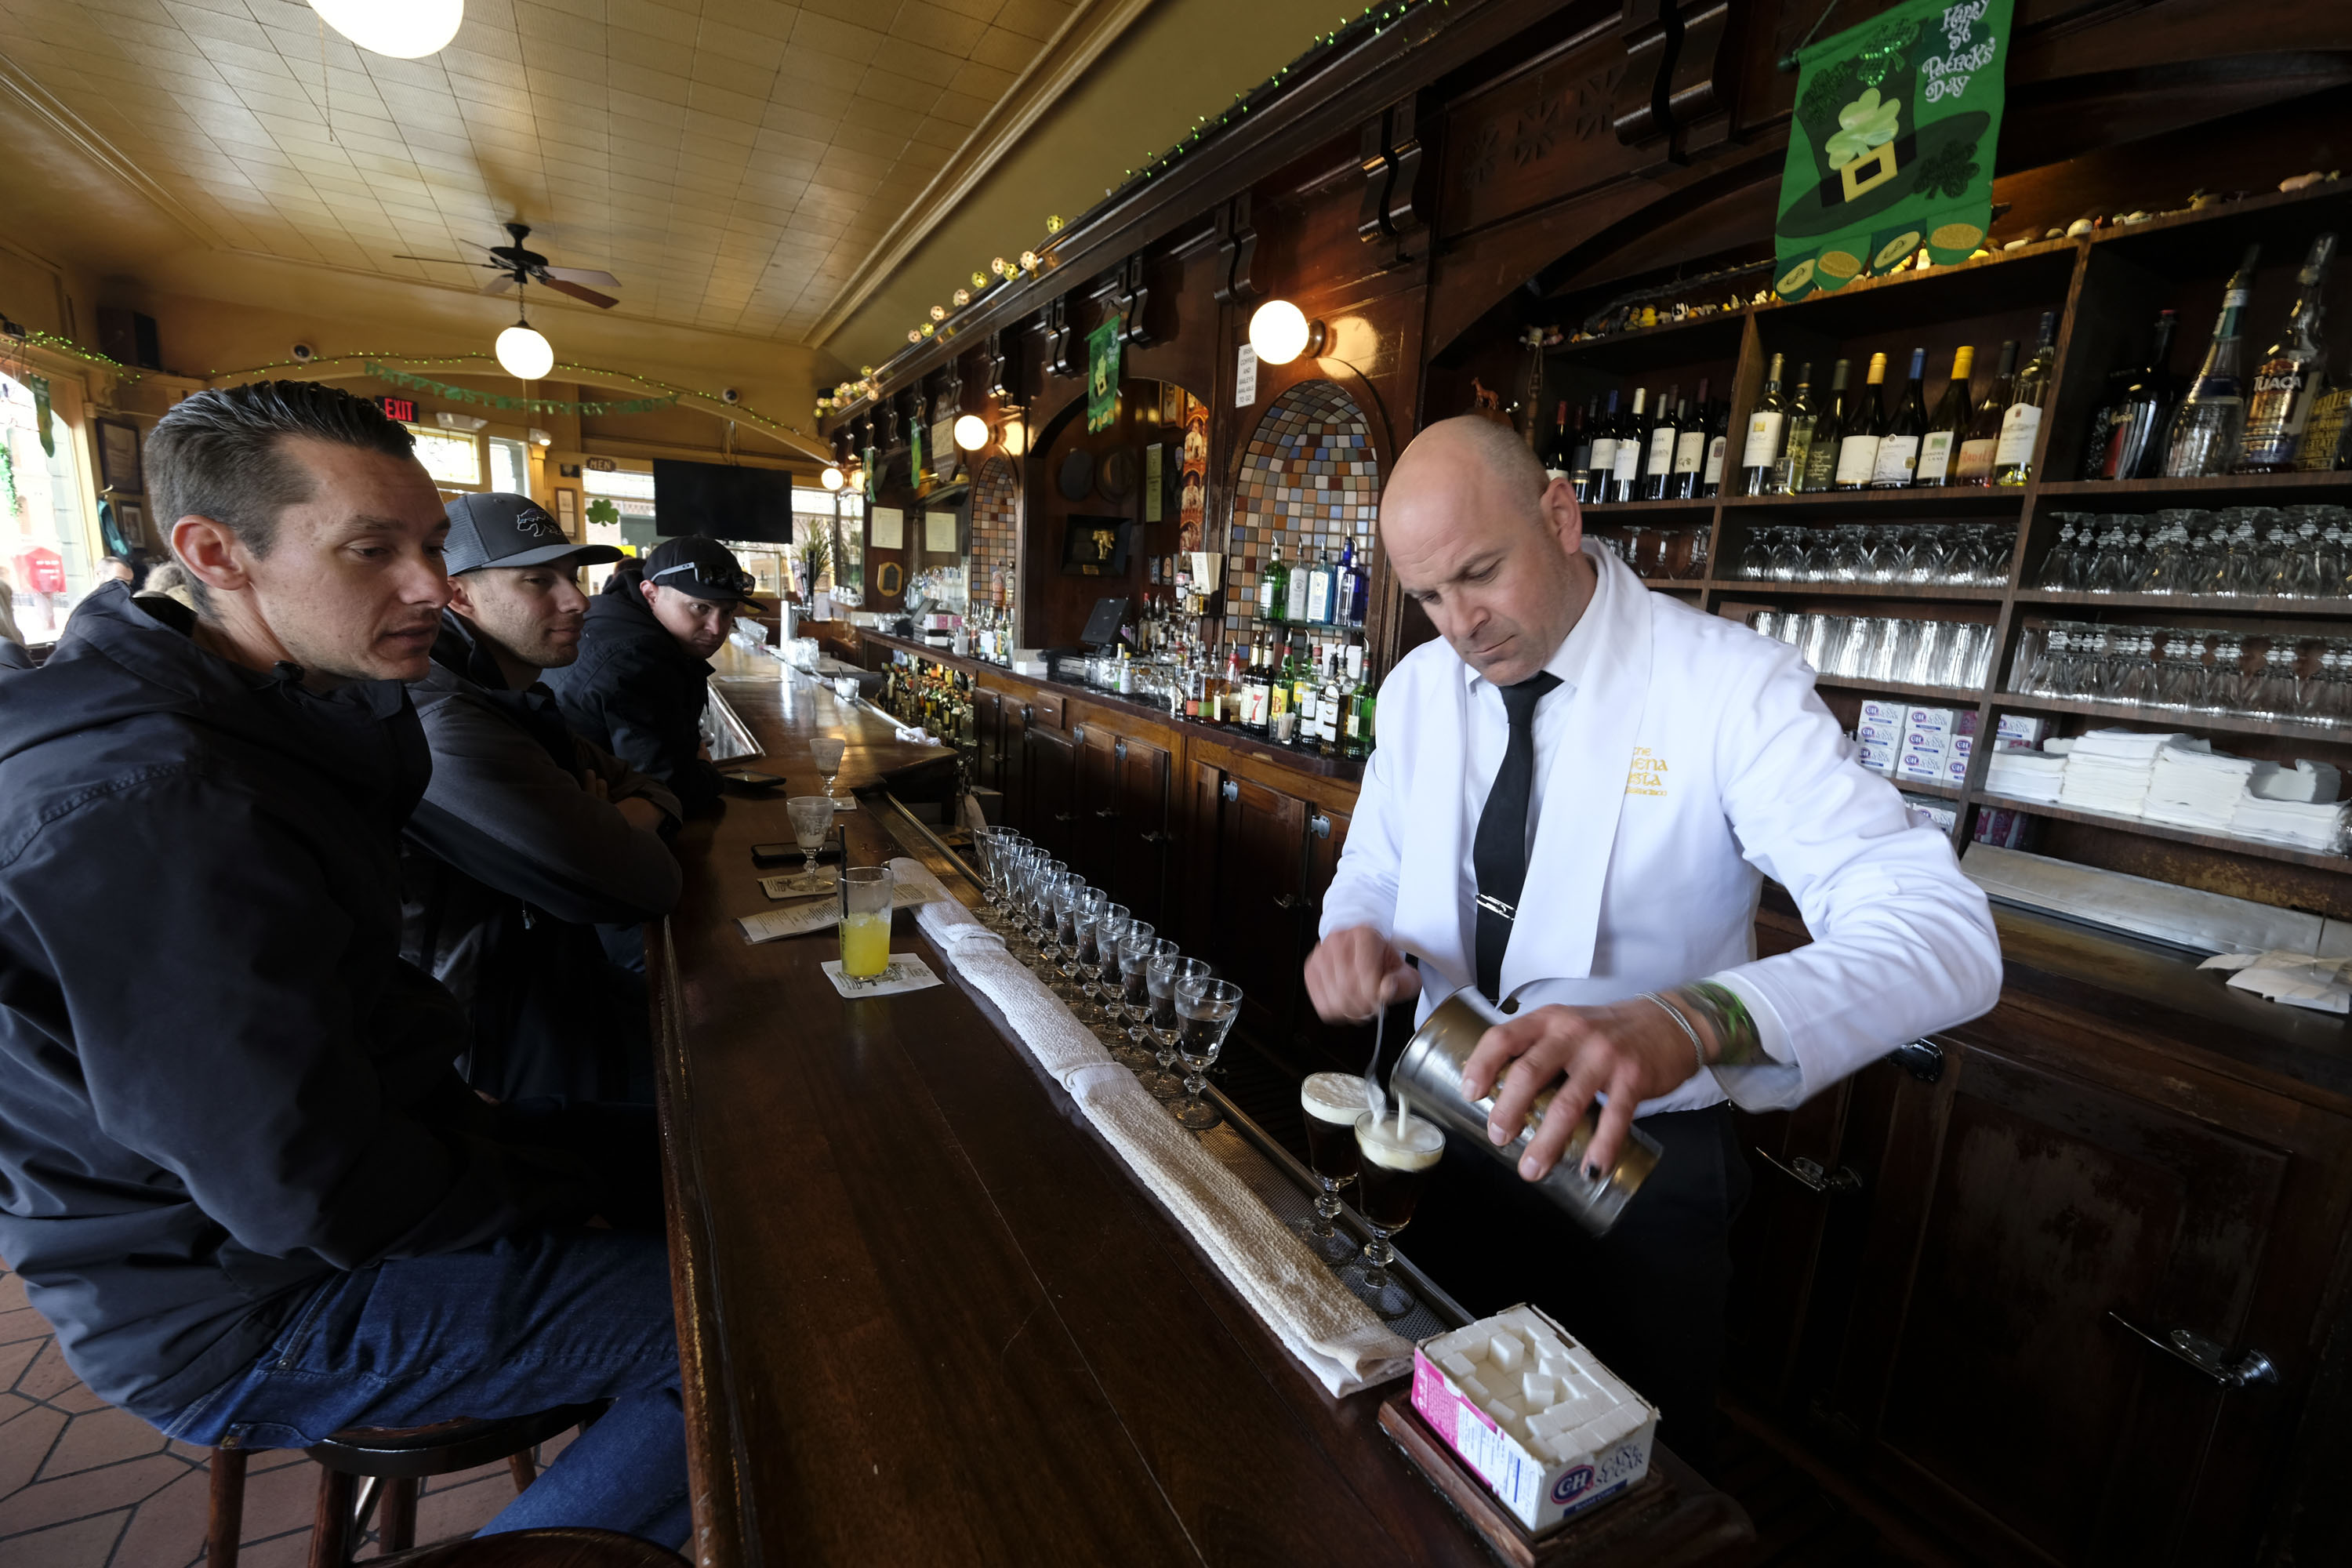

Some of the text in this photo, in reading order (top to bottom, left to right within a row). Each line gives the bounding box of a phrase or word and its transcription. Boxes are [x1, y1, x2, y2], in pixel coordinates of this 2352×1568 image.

[1940, 0, 1990, 32] Happy
[1947, 19, 1971, 50] St
[1926, 75, 1971, 103] Day
[2252, 375, 2302, 392] TUACA
[384, 397, 413, 422] EXIT
[590, 459, 612, 470] MEN
[1251, 694, 1263, 721] 7
